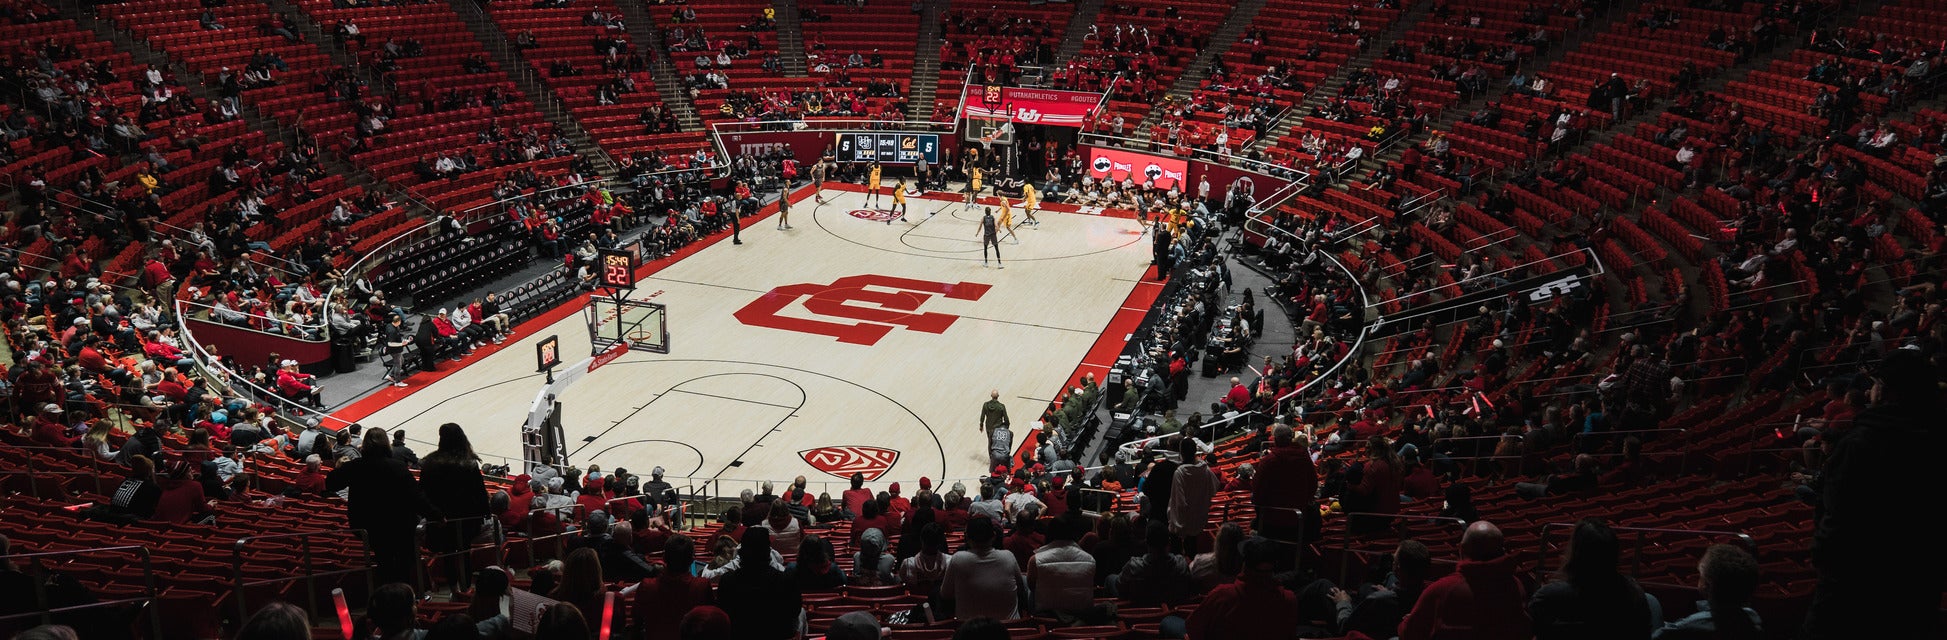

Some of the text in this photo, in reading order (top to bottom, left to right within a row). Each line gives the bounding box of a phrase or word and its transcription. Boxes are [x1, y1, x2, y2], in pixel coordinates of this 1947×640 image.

[986, 92, 999, 102] 22
[1008, 91, 1058, 101] @UTAHATHLETICS
[1070, 95, 1098, 104] #GOUTES
[902, 137, 917, 149] Cal
[607, 266, 626, 285] 22
